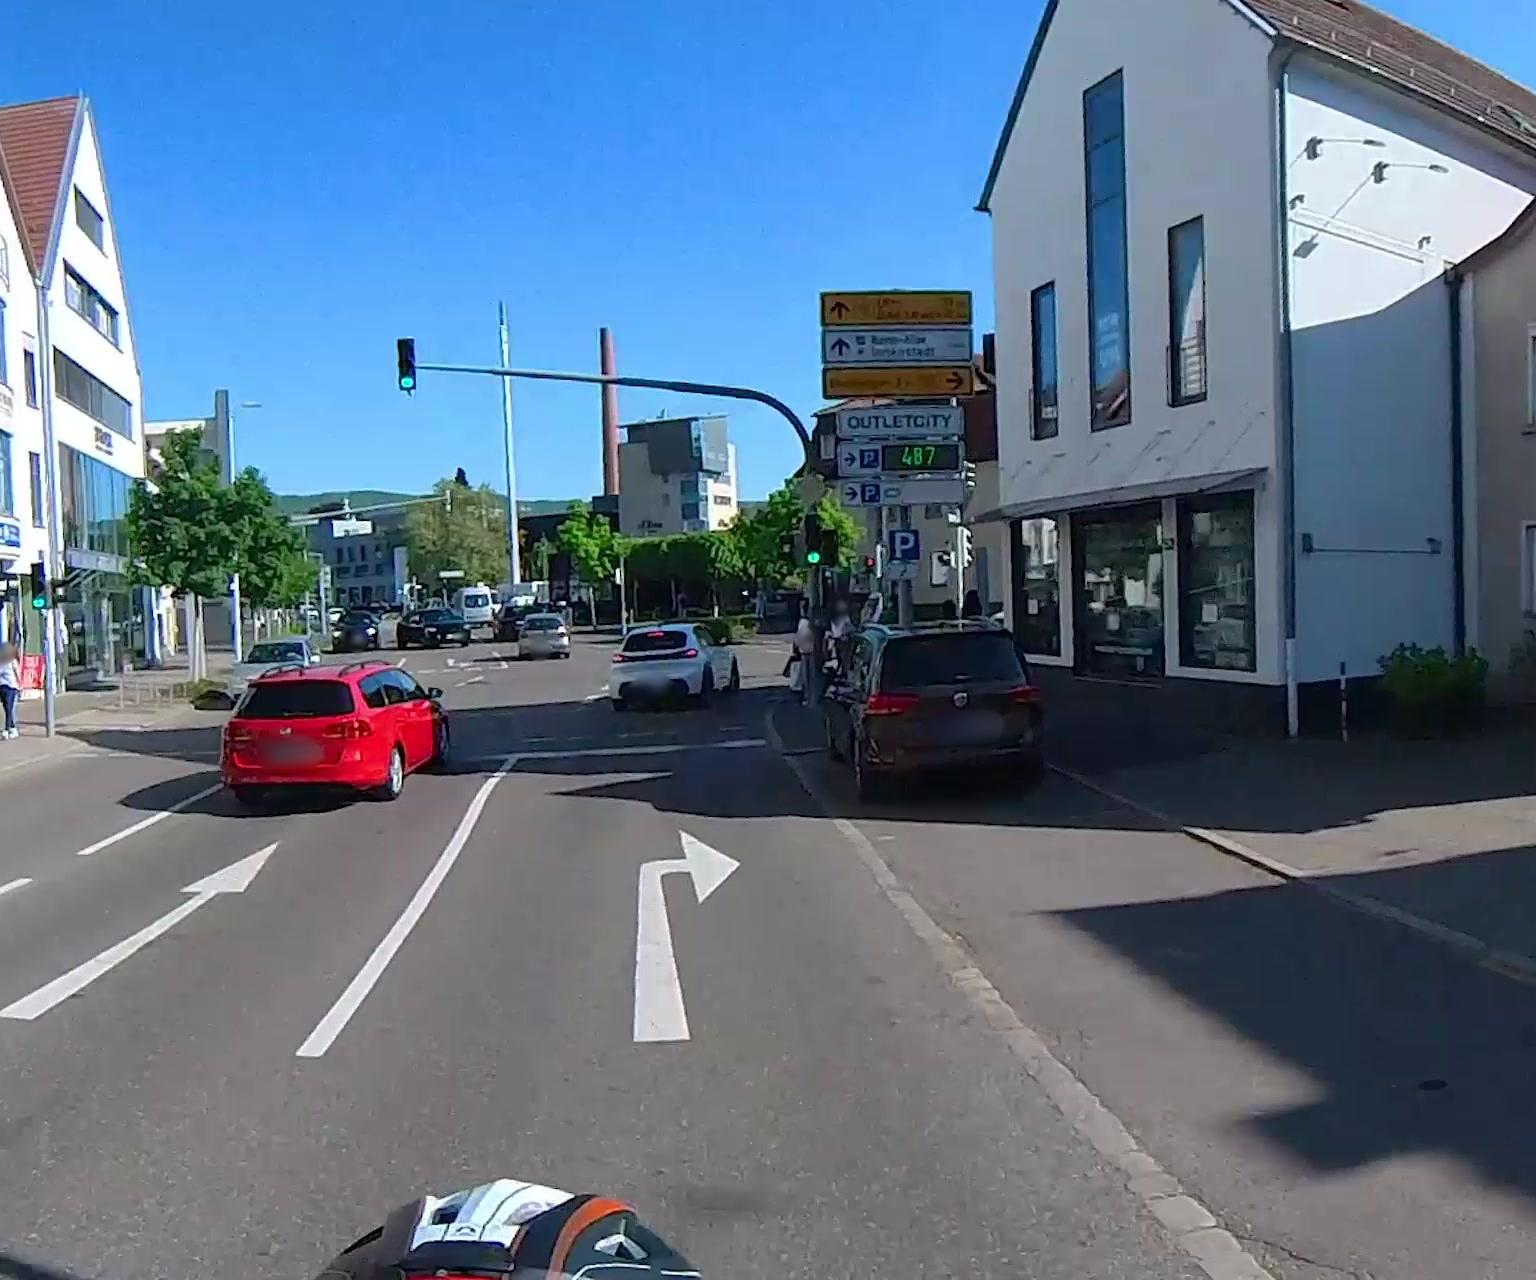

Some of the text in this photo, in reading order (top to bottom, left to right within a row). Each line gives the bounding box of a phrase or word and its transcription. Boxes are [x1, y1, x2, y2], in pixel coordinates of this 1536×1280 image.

[847, 413, 953, 430] OUTLETCITY
[901, 445, 937, 466] 487
[894, 532, 915, 558] P
